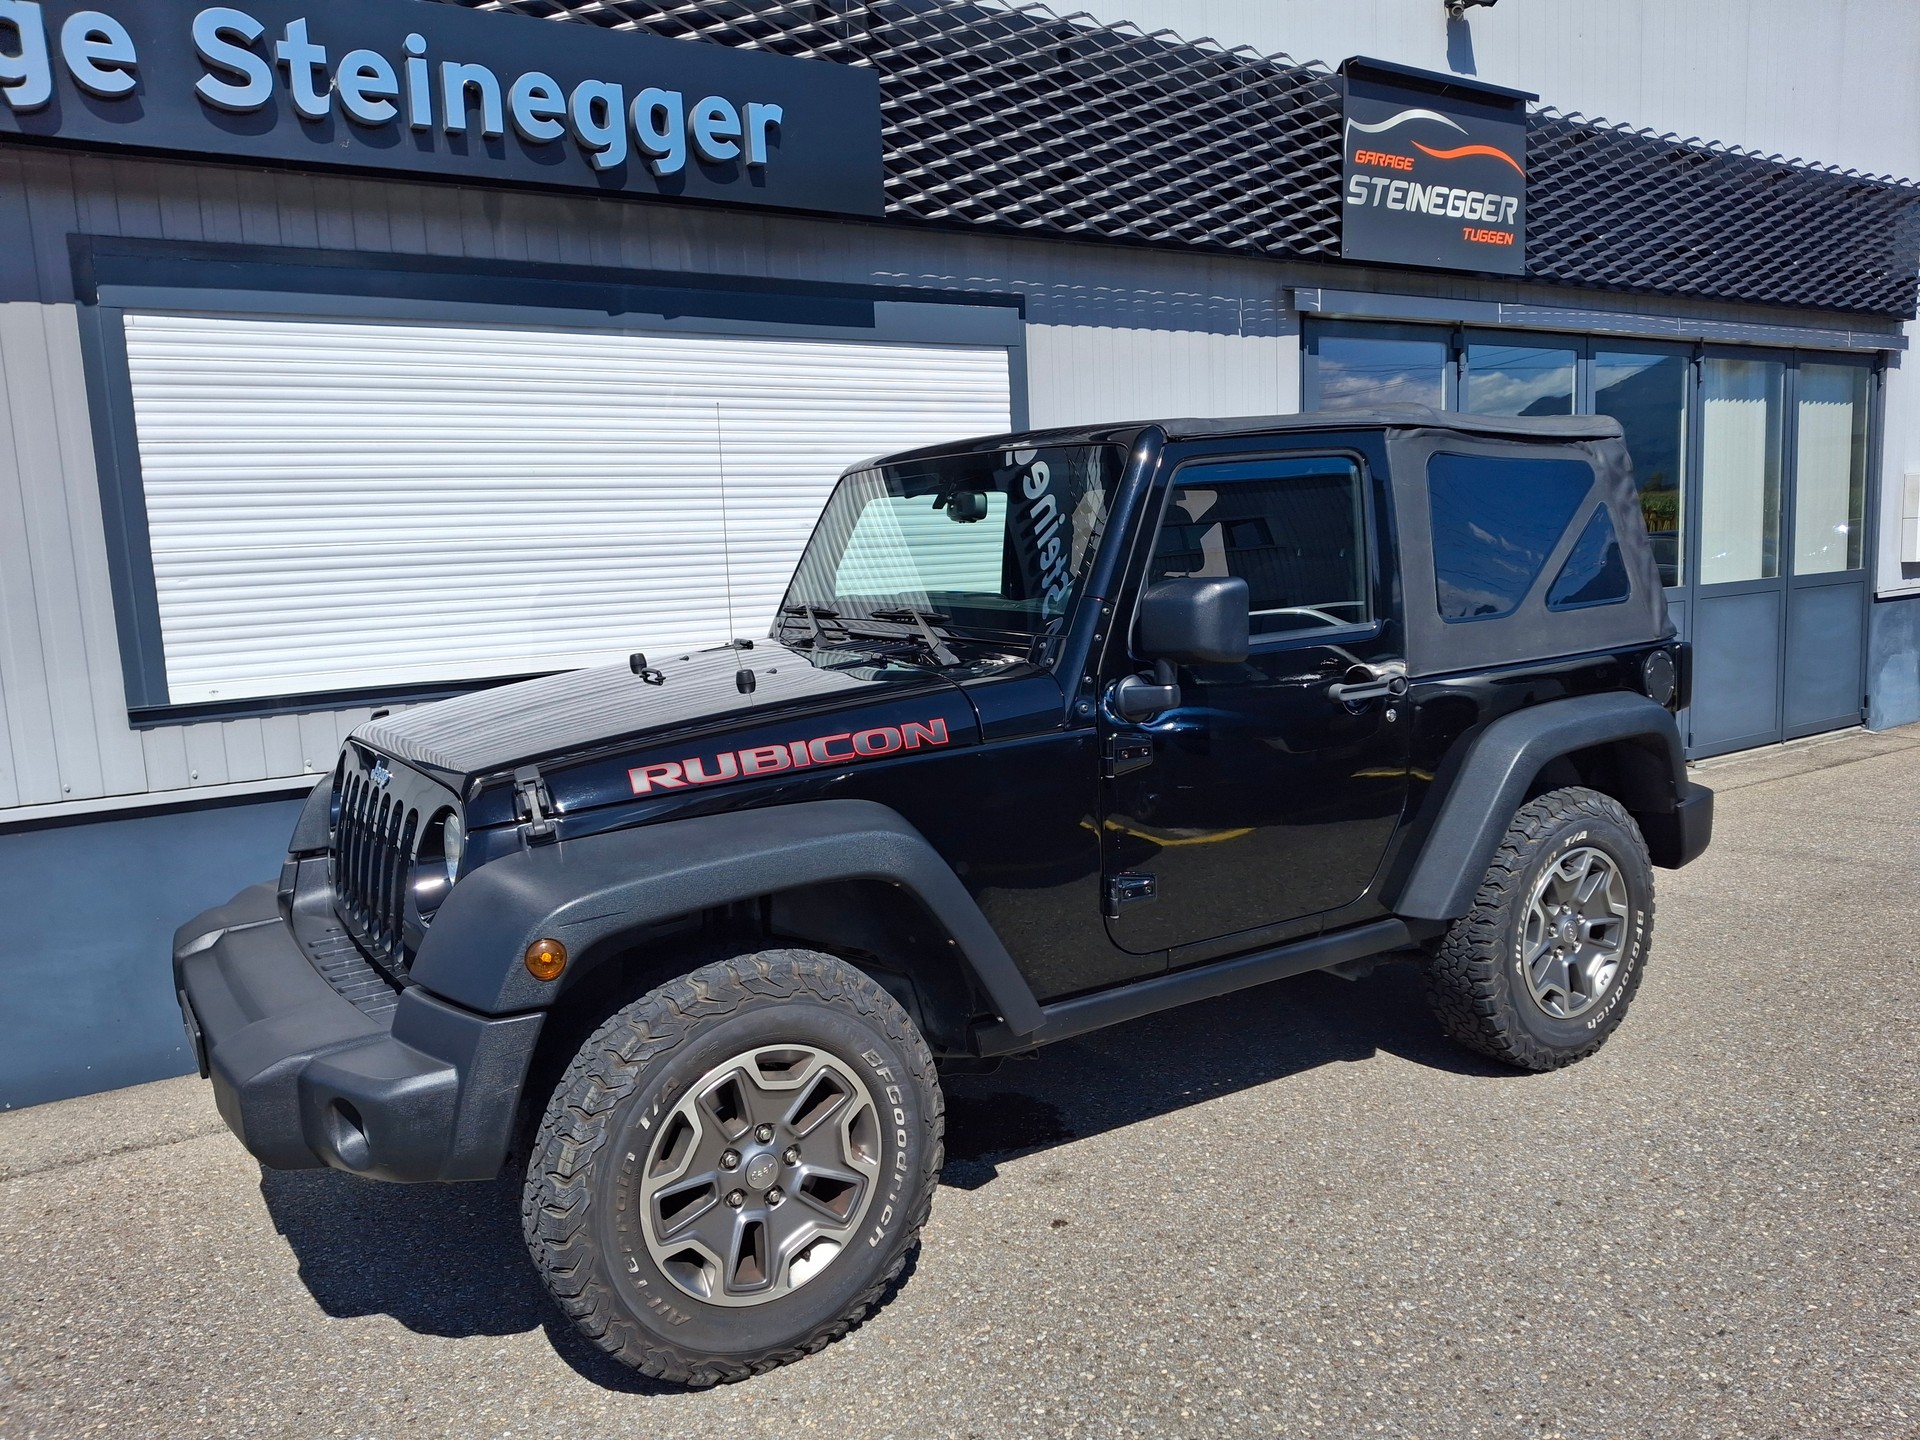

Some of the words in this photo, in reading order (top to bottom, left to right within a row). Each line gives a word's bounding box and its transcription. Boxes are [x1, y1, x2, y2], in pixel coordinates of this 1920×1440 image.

[0, 0, 137, 107] ge
[191, 7, 784, 175] Steinegger
[1354, 149, 1415, 171] GARAGE
[1346, 174, 1519, 225] STEINEGGER
[1463, 227, 1515, 246] TUGGEN
[627, 718, 949, 794] RUBICON
[1564, 830, 1588, 848] T/A
[1587, 910, 1645, 1030] BFGoodrich
[861, 1049, 908, 1248] BFGoodrich
